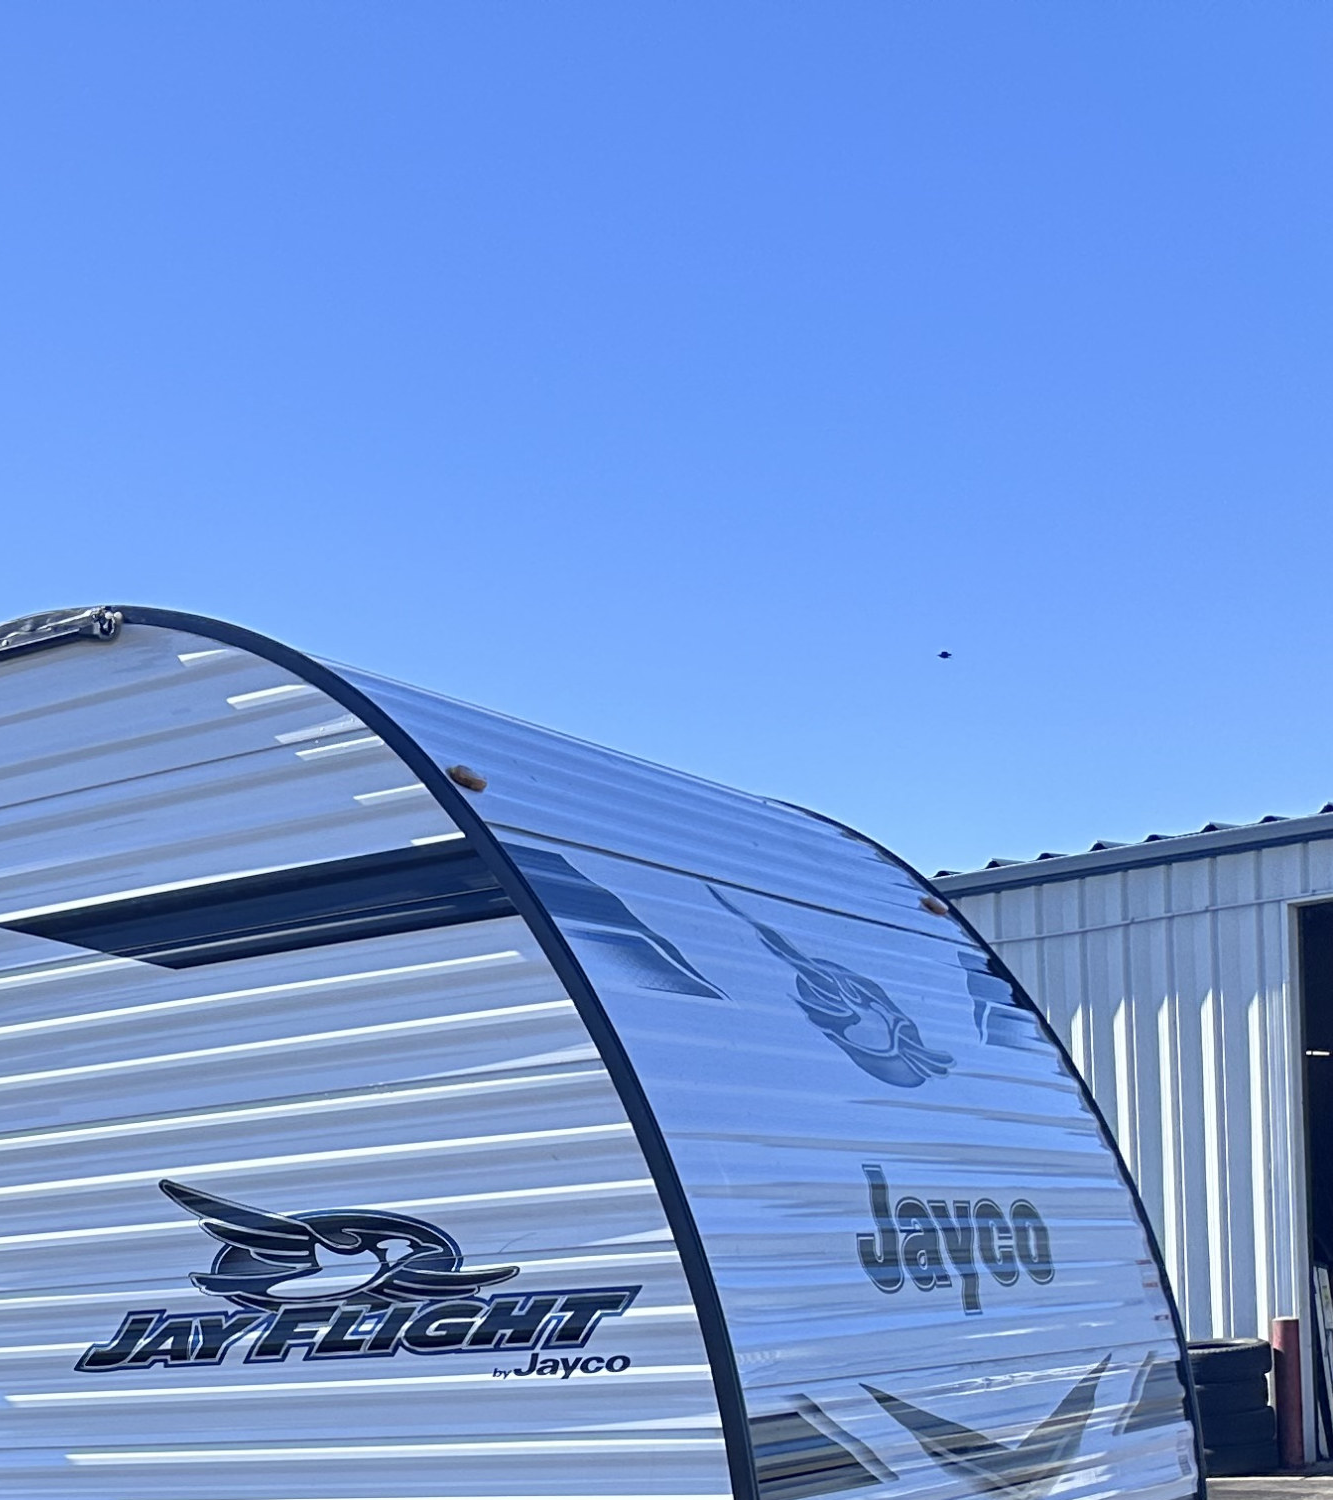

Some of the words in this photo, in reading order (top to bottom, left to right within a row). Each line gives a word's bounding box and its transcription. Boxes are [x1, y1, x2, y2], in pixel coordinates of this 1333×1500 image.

[856, 1164, 1055, 1316] Jayco
[492, 1367, 512, 1380] by
[513, 1352, 631, 1379] Jayco
